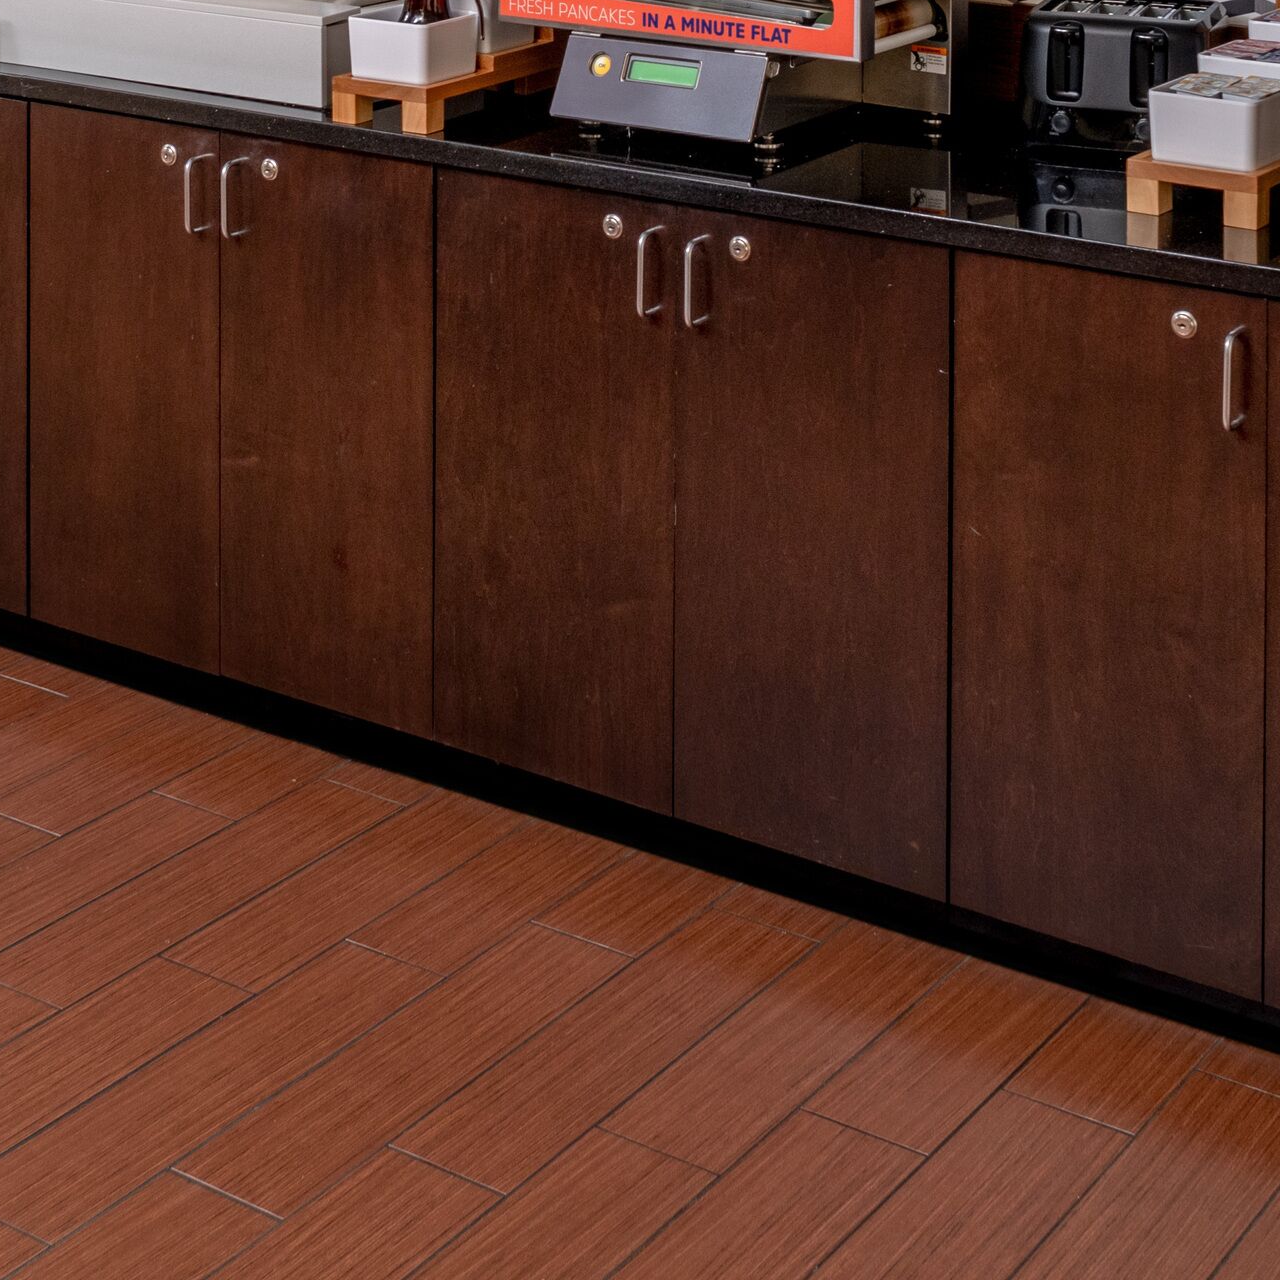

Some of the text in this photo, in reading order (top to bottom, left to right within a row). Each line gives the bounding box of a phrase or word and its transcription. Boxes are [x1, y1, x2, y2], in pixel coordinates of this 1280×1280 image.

[558, 2, 636, 26] PANCAKES
[642, 12, 659, 29] IN
[664, 15, 676, 30] A
[681, 17, 745, 39] MINUTE
[751, 25, 791, 44] FLAT
